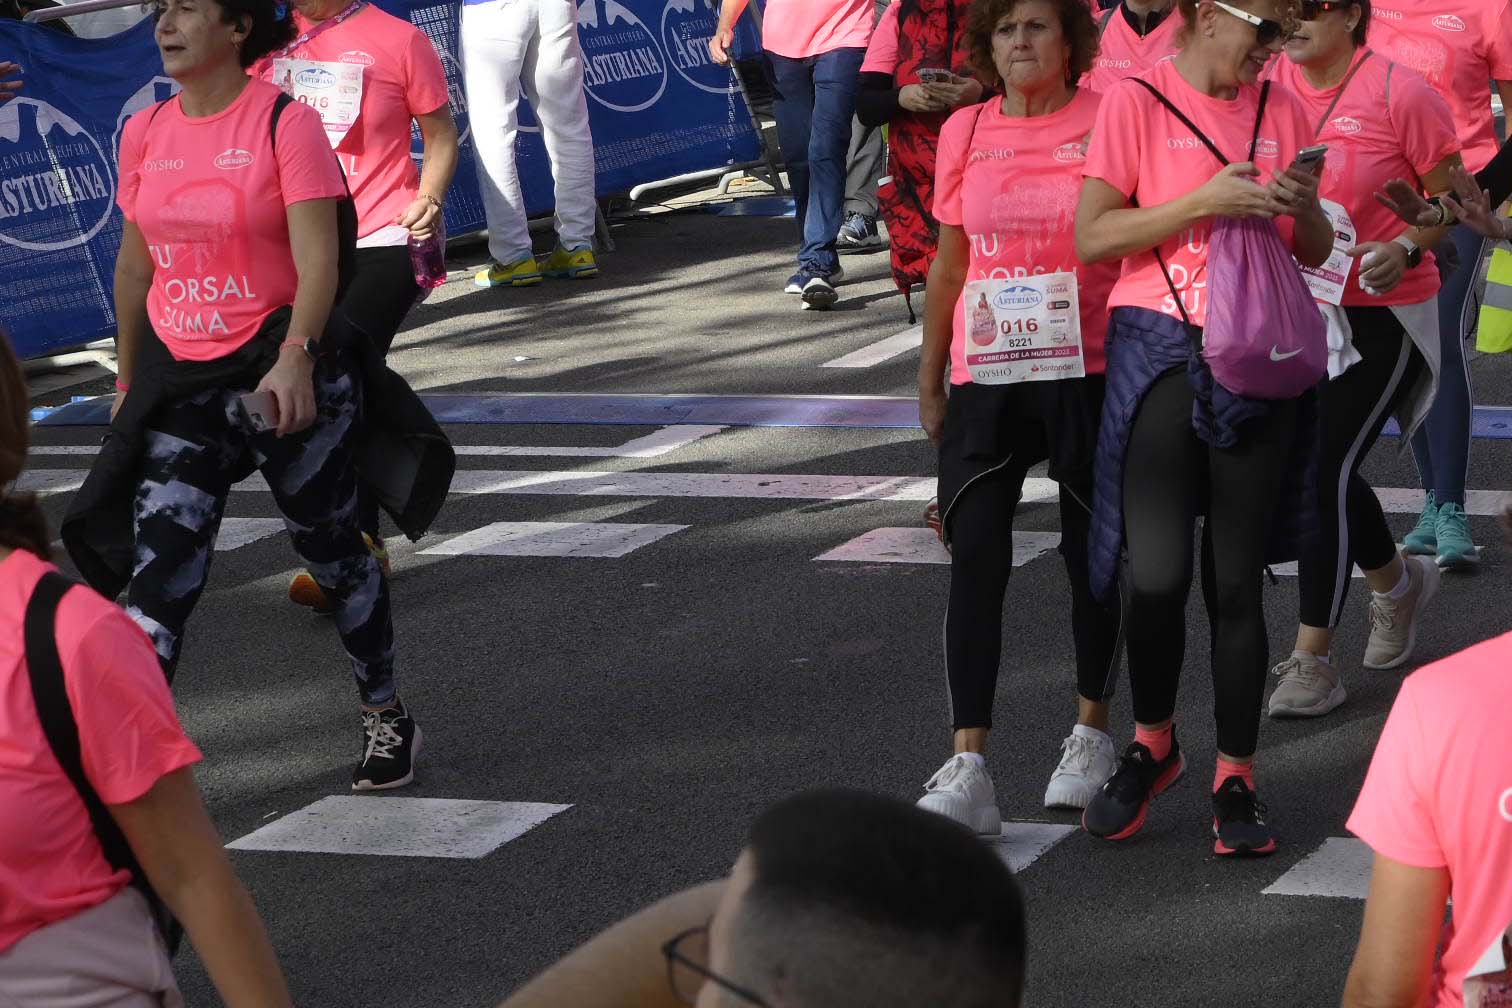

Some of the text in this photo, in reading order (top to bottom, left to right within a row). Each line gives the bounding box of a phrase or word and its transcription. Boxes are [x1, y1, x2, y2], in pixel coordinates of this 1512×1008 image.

[583, 46, 663, 87] ASTURIANA
[970, 233, 998, 257] TU
[164, 275, 256, 304] ORSAL
[999, 296, 1039, 305] ASTURIANA
[160, 306, 229, 334] SUMA
[1000, 317, 1039, 334] 016
[1008, 337, 1033, 348] 8221
[978, 354, 1009, 362] CARRERA
[978, 367, 1012, 379] OYSHO
